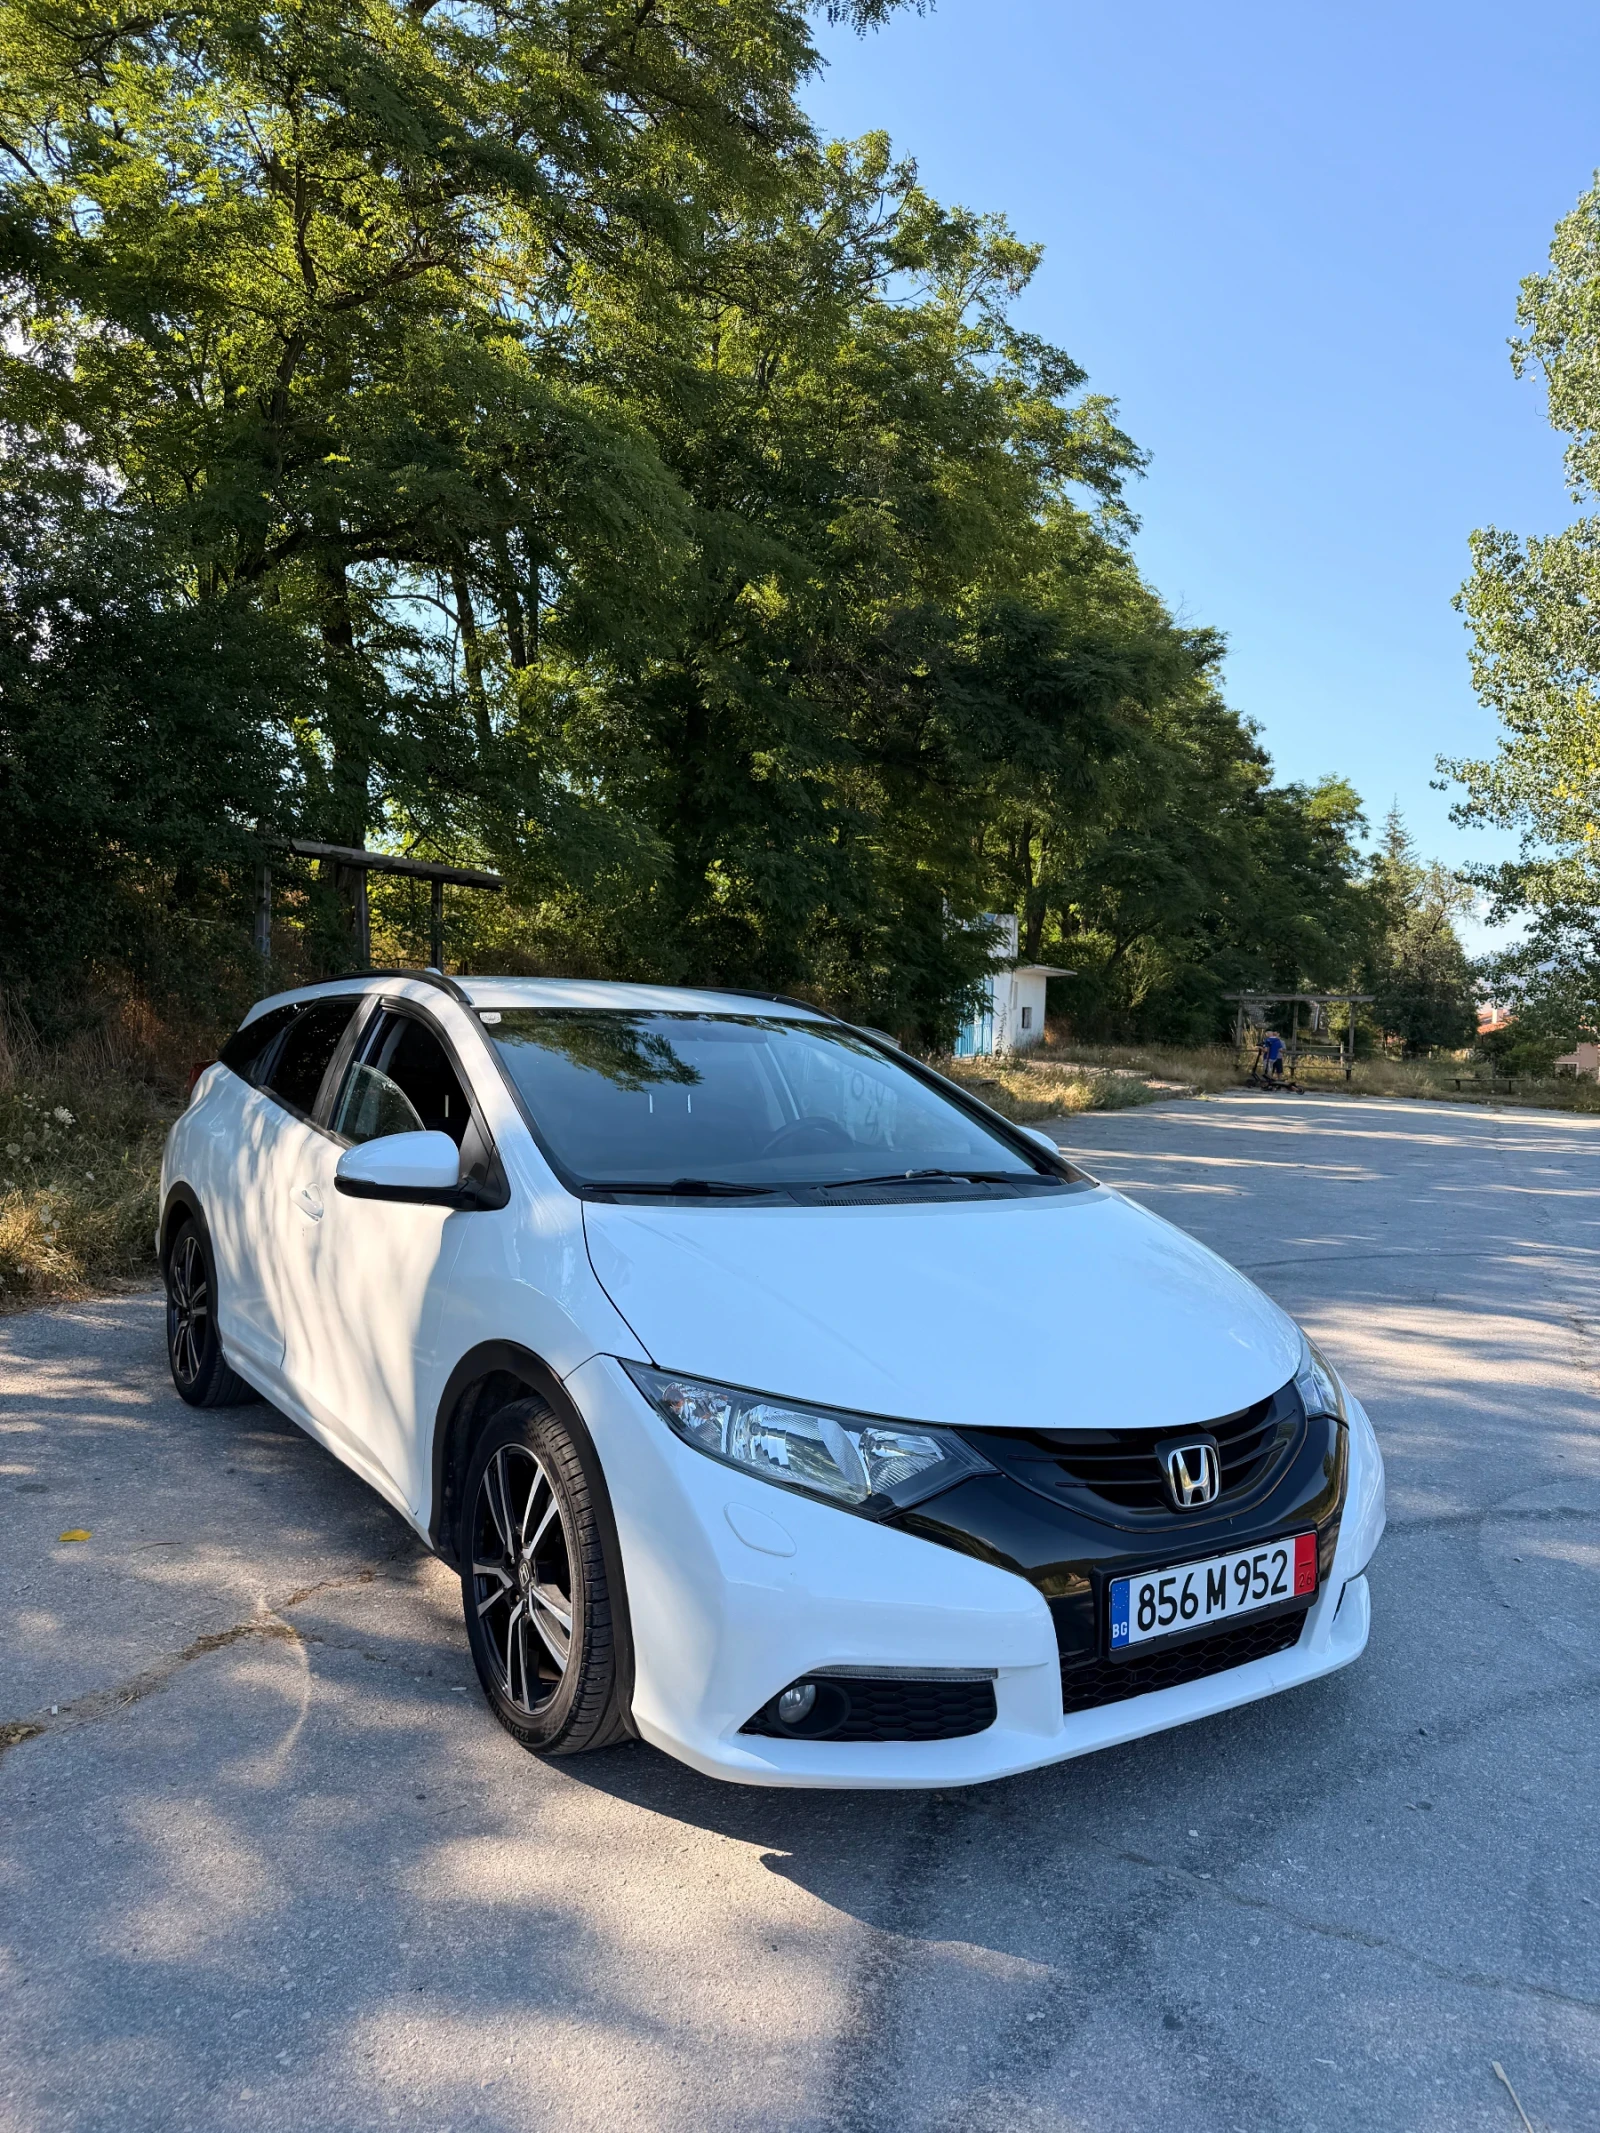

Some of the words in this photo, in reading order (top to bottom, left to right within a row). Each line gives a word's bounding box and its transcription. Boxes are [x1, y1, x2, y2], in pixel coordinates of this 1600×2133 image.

[1298, 1570, 1313, 1588] 26
[1138, 1572, 1199, 1632] 856
[1206, 1564, 1227, 1615] M
[1233, 1549, 1288, 1606] 952
[1112, 1621, 1128, 1639] BG
